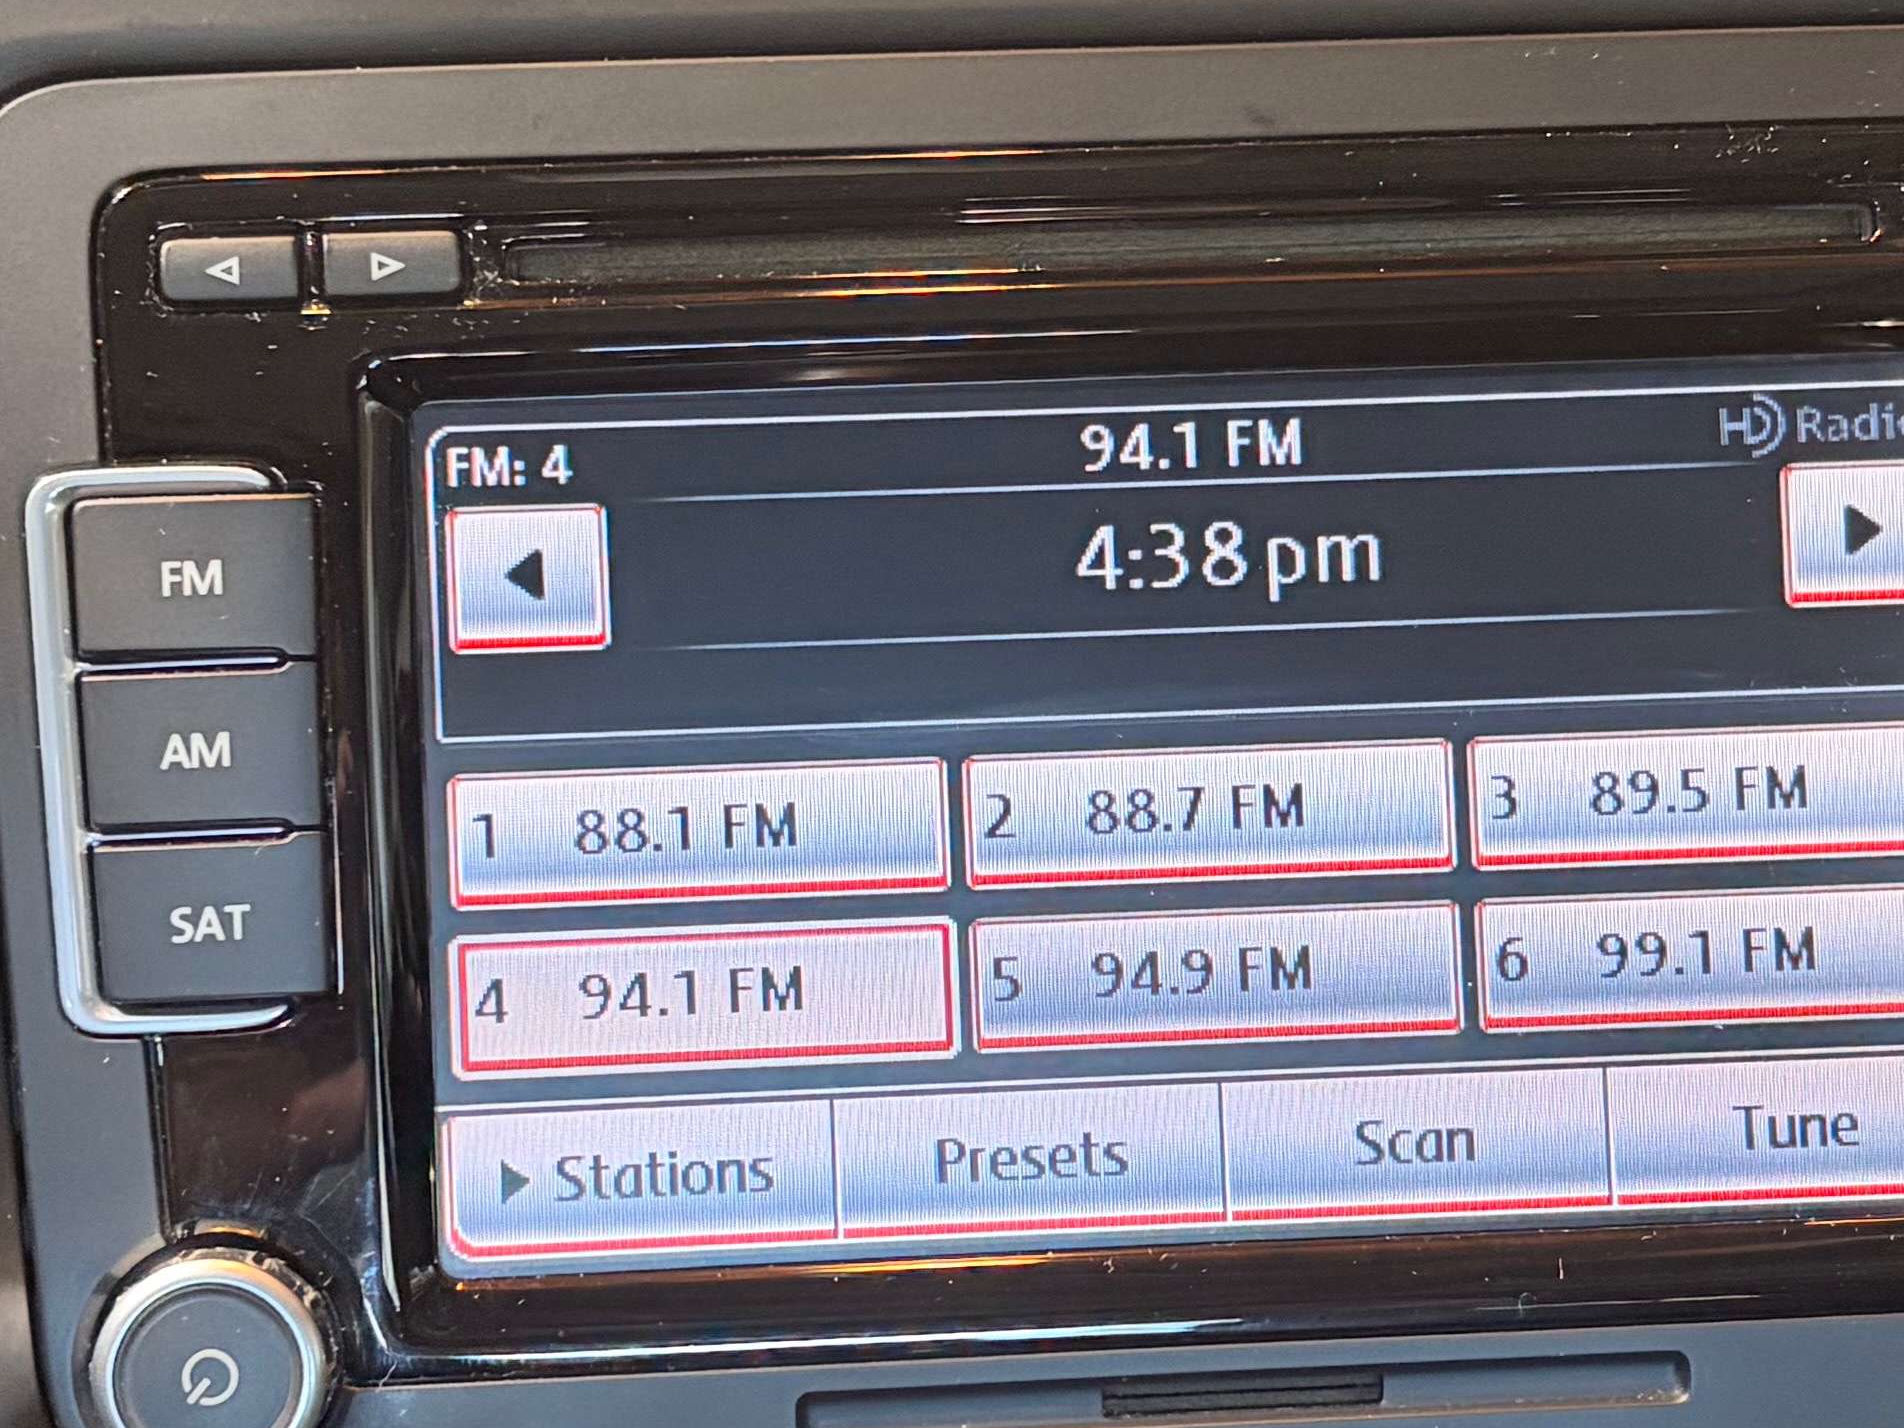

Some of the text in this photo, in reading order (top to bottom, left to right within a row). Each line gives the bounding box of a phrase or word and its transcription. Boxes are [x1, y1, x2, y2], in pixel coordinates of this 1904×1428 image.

[446, 444, 574, 488] FM: 4
[1080, 418, 1302, 472] 94.1 FM
[160, 558, 224, 598] FM
[1075, 521, 1381, 603] 4:38 pm
[159, 731, 232, 771] AM
[984, 783, 1305, 840] 2 88.7 FM
[1490, 764, 1808, 821] 3 89.5 FM
[471, 801, 800, 860] 1 88.1 FM
[169, 903, 251, 945] SAT
[992, 944, 1313, 1003] 5 94.9 FM
[1497, 925, 1817, 982] 6 99.1 FM
[474, 965, 804, 1025] 4 94.1 FM
[1355, 1118, 1476, 1167] Scan
[1731, 1104, 1861, 1152] Tune
[553, 1153, 775, 1205] Stations
[934, 1132, 1130, 1186] Presets
